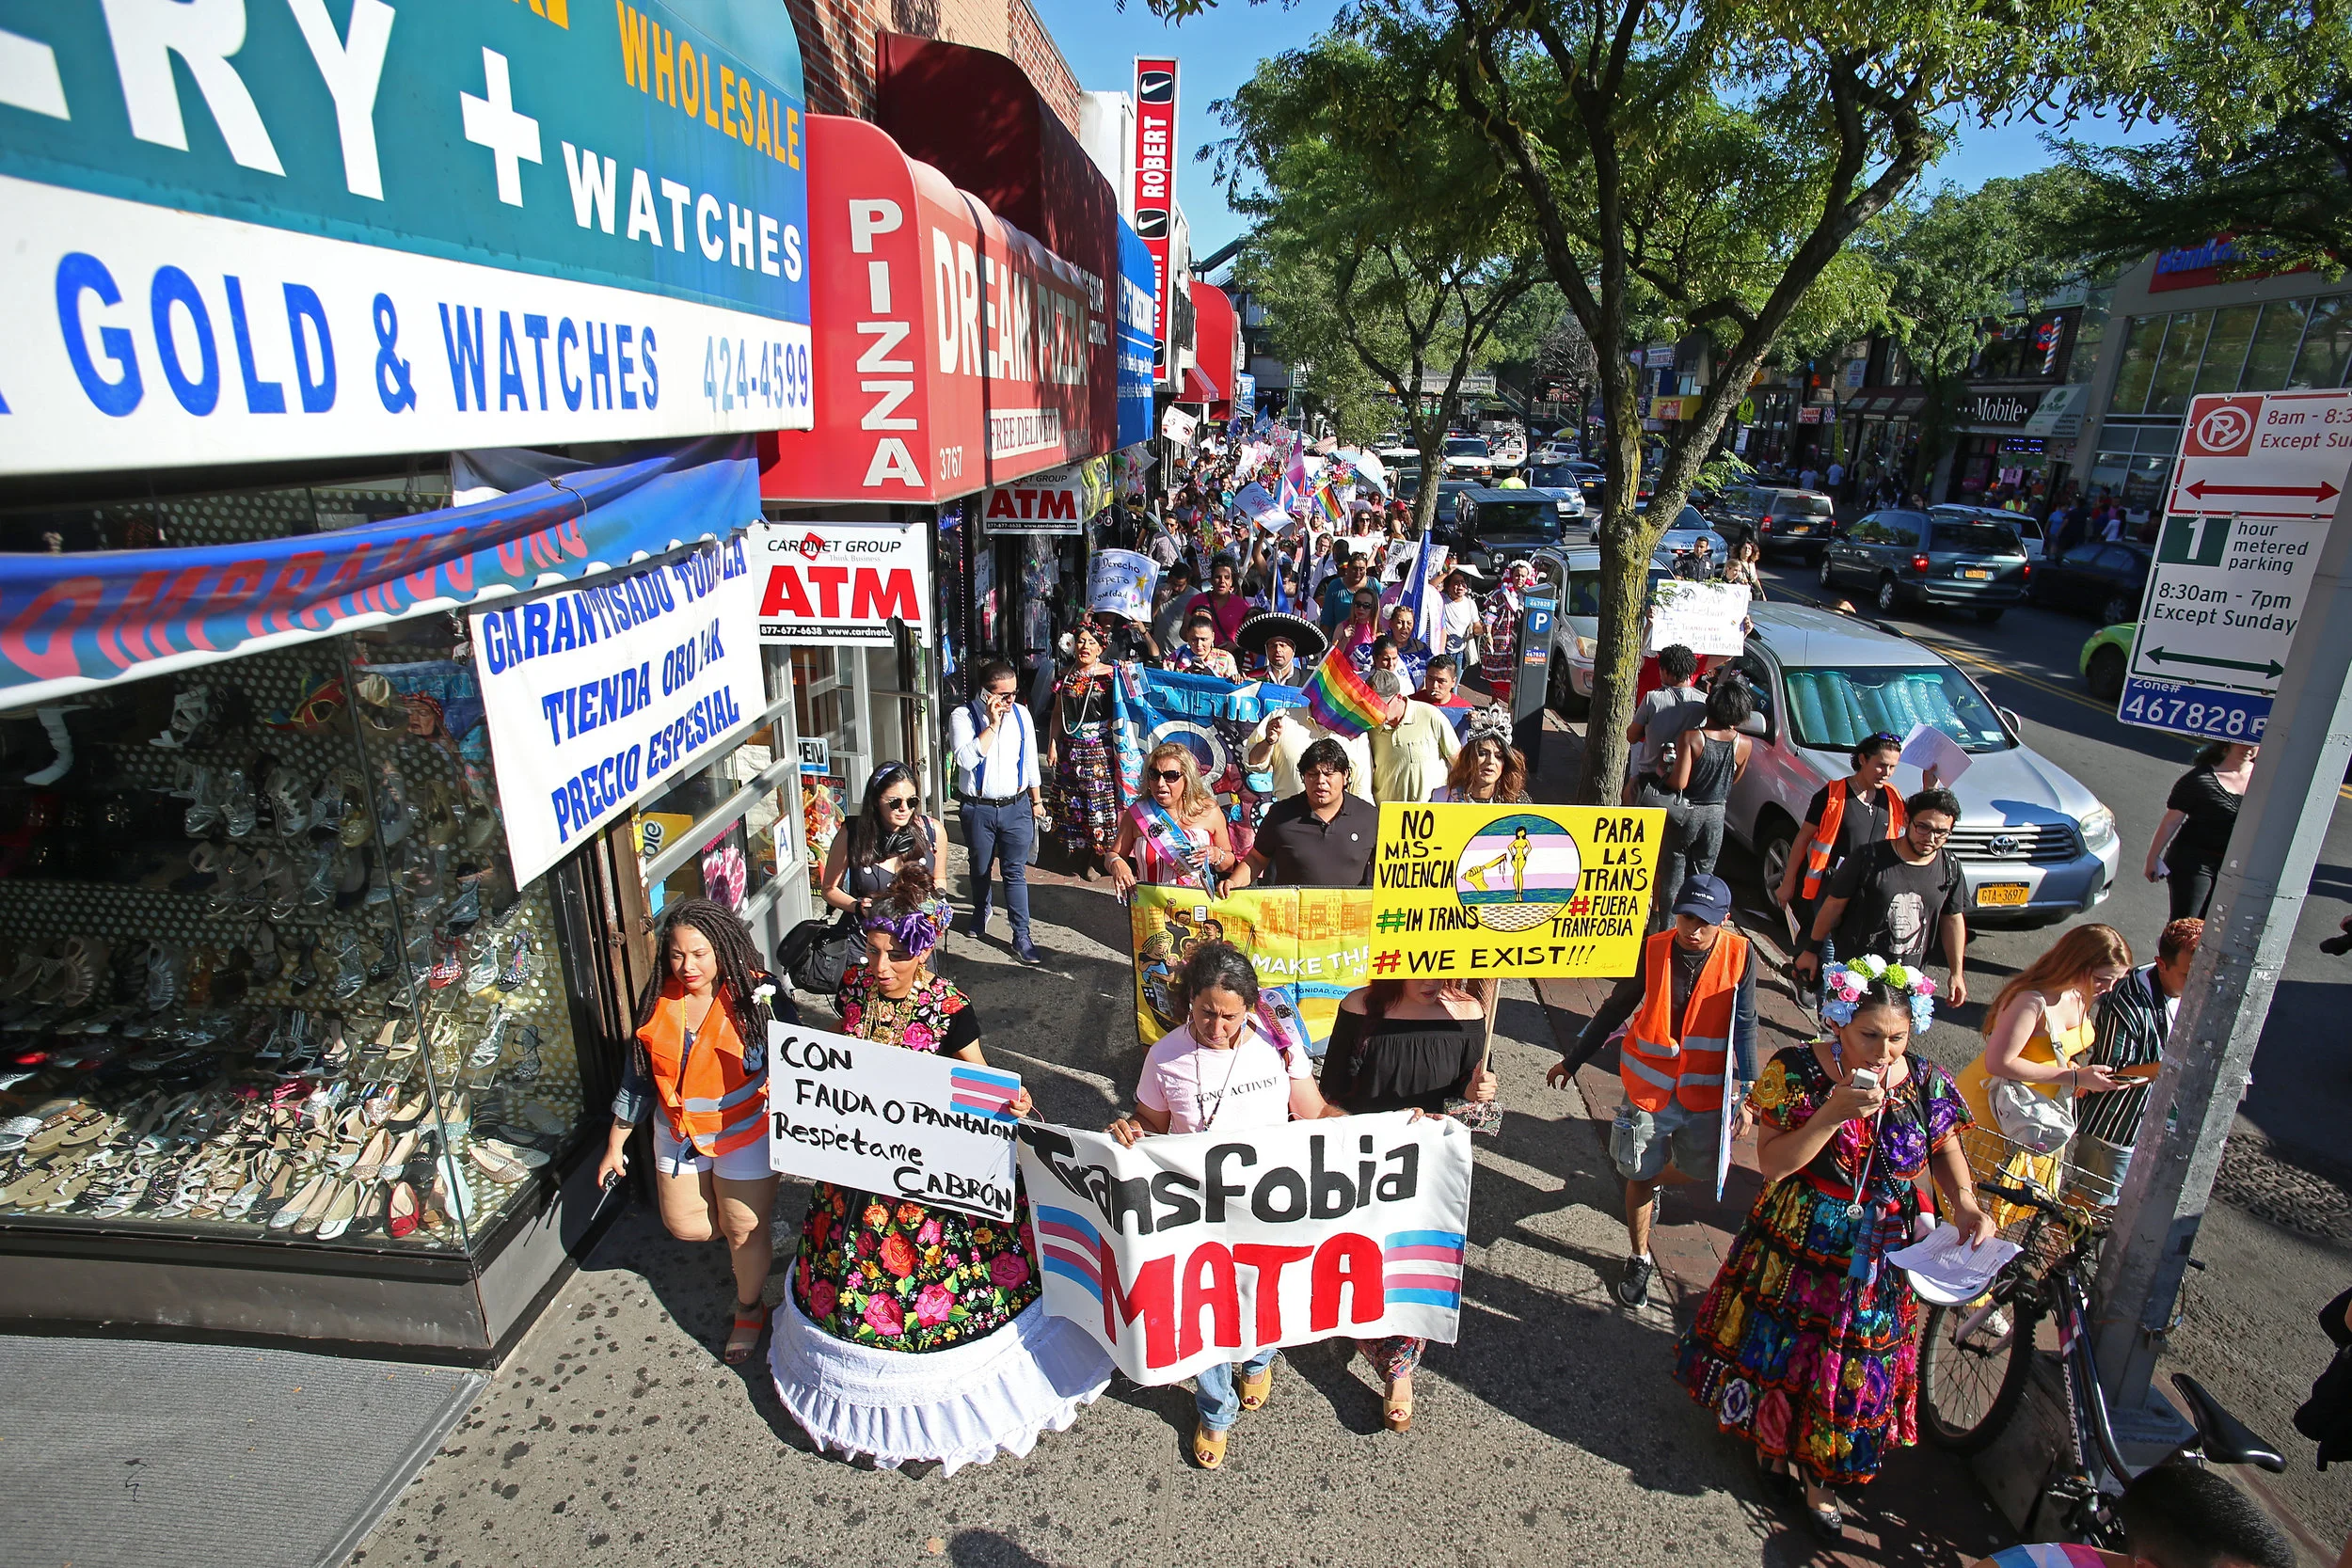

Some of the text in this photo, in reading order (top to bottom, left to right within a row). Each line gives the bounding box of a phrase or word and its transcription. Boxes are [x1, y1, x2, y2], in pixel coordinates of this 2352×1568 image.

[617, 0, 802, 171] WHOLESALE
[1142, 115, 1167, 199] ROBERT
[562, 140, 803, 283] WATCHES
[931, 226, 1032, 382] DREAM
[1038, 283, 1088, 387] PIZZA
[55, 251, 810, 417] GOLD & WATCHES 424-4599
[849, 198, 926, 487] PIZZA
[2267, 409, 2305, 425] 8am
[990, 416, 1015, 452] FREE
[1017, 414, 1057, 448] DELIVERY
[2260, 432, 2322, 451] Except
[940, 445, 963, 481] 3767
[986, 489, 1077, 520] ATM
[768, 539, 901, 553] CARDNET GROUP
[2187, 516, 2279, 560] 1 hour
[2233, 538, 2309, 557] metered
[829, 554, 849, 562] Think
[1102, 558, 1140, 574] Derecho
[2228, 555, 2294, 576] parking
[758, 564, 921, 621] ATM
[2158, 582, 2229, 604] 8:30am
[2249, 590, 2292, 610] 7pm
[482, 564, 675, 676] GARANTISADO
[761, 626, 822, 636] 877-677-6638
[2153, 603, 2298, 636] Except Sunday
[541, 660, 651, 748] TIENDA
[662, 636, 696, 697] ORO
[2125, 694, 2247, 736] 467828
[551, 685, 740, 845] PRECIO ESPESIAL
[819, 777, 845, 788] Gyro
[1401, 810, 1435, 840] NO
[1593, 816, 1645, 844] PARA
[778, 827, 788, 858] A
[1602, 847, 1643, 865] LAS
[1378, 860, 1454, 889] VIOLENCIA
[1582, 868, 1648, 893] TRANS
[1428, 905, 1480, 931] TRANS
[1250, 953, 1324, 975] MAKE
[1470, 945, 1596, 970] EXIST!!!
[1291, 987, 1330, 995] DIGNIDAD,
[780, 1036, 853, 1071] CON
[1230, 1076, 1278, 1097] ACTIVIST
[882, 1100, 905, 1124] O
[1017, 1121, 1419, 1235] Transfobia
[1100, 1232, 1384, 1370] MATA
[2062, 1363, 2084, 1466] ROADMASTER
